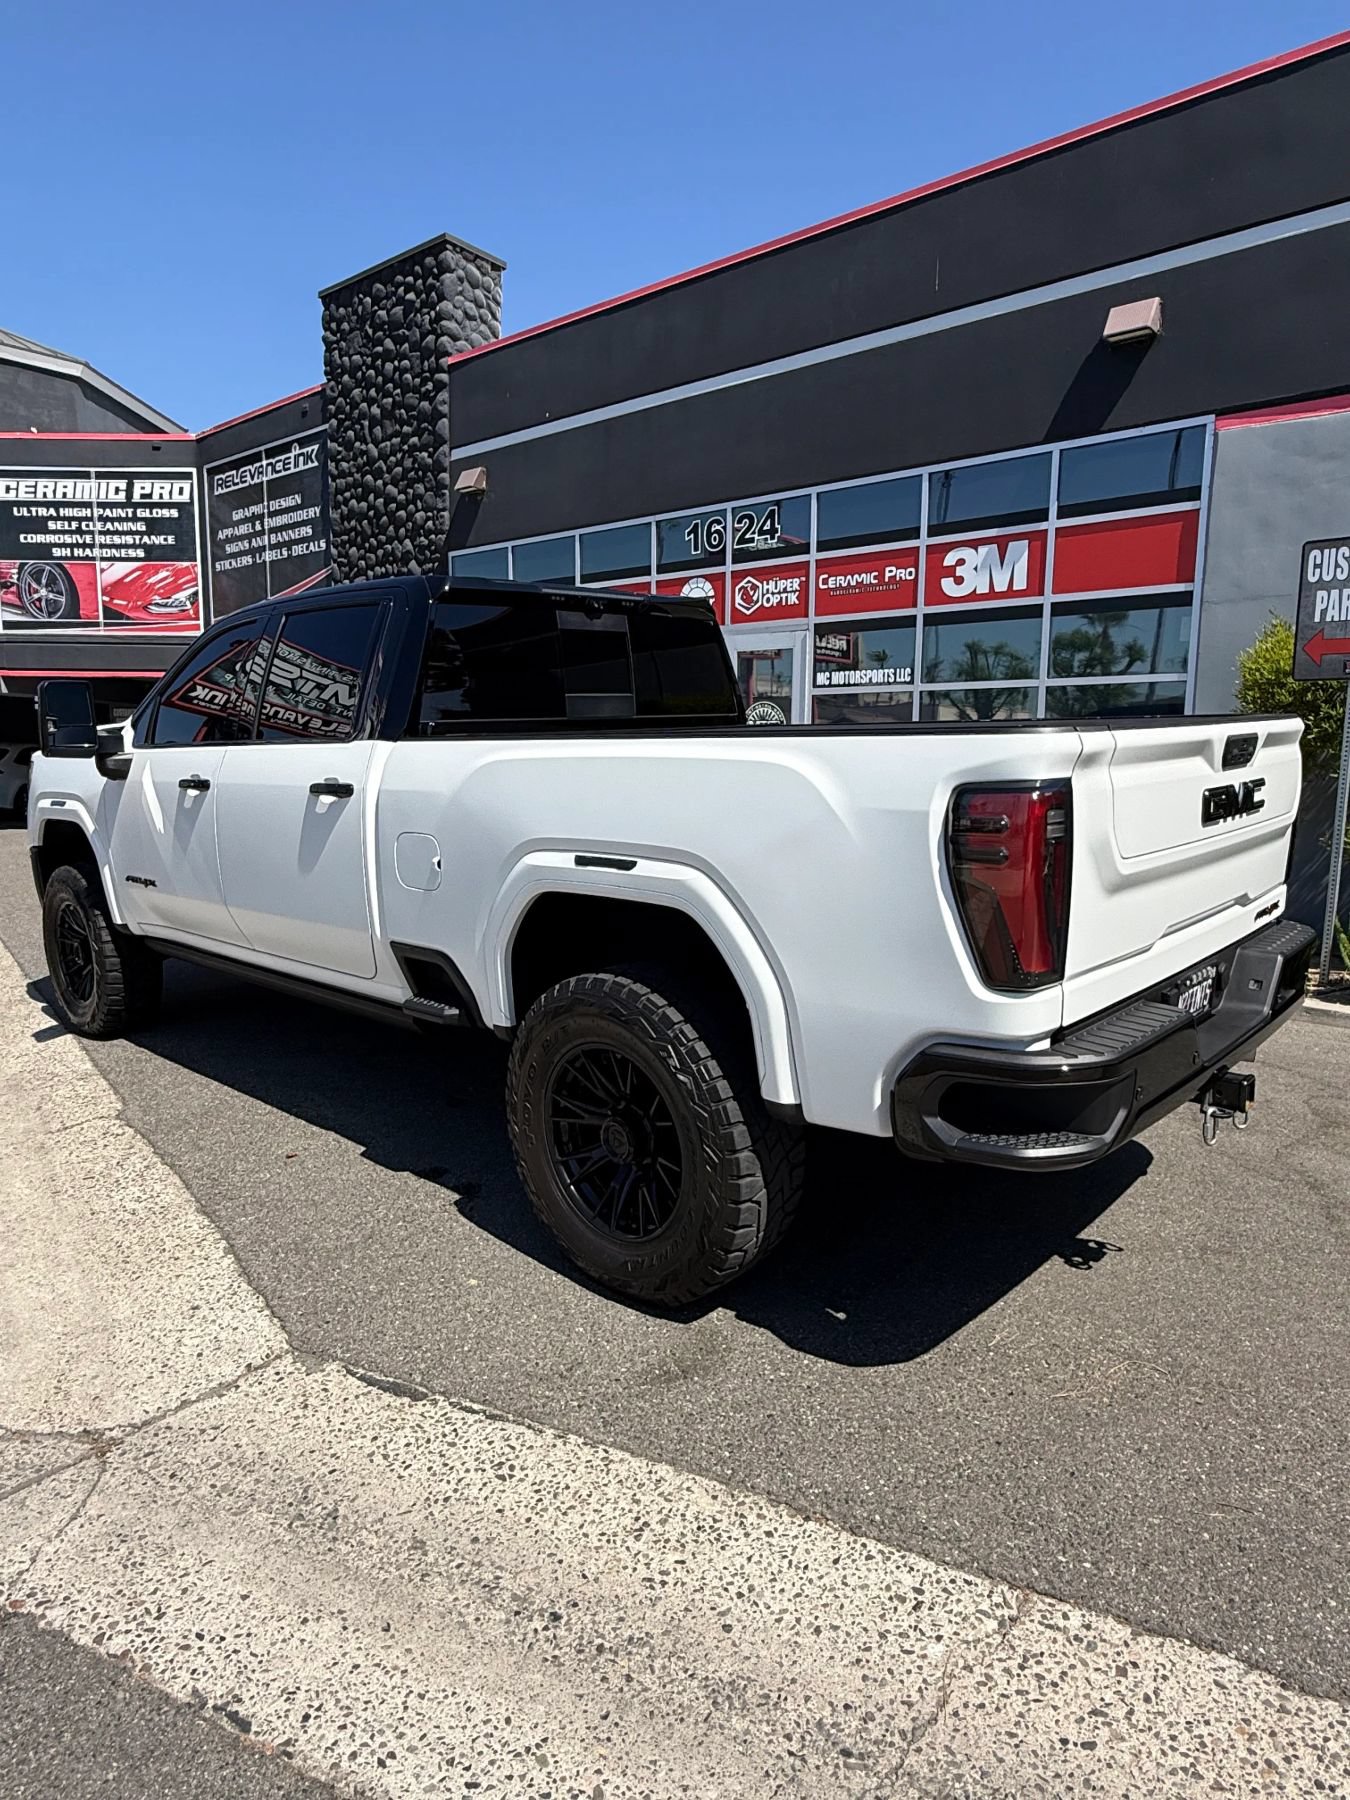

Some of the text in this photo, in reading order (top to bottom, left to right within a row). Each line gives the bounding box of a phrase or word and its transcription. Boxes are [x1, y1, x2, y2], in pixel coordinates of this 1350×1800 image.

[214, 455, 292, 495] RELEVANCE
[0, 479, 191, 502] CERAMIC PRO
[13, 507, 179, 518] ULTRA HIGH PAINT GLOSS
[269, 493, 301, 512] DESIGN
[48, 521, 146, 531] SELF CLEANING
[217, 506, 321, 541] APPAREL & EMBROIDERY
[685, 506, 780, 555] 16 24
[20, 533, 176, 545] CORROSIVE RESISTANCE
[225, 525, 313, 554] SIGNS AND BANNERS
[52, 547, 145, 558] 9H HARDNESS
[215, 539, 326, 572] STICKERS LABELS DECALS
[940, 539, 1029, 598] 3M
[1307, 546, 1350, 583] CUS
[763, 577, 800, 594] HÜPER
[818, 566, 916, 589] CERAMIC PRO
[763, 592, 800, 608] OPTIK
[816, 667, 911, 686] MC MOTORSPORTS LLC
[1202, 778, 1265, 827] GMC
